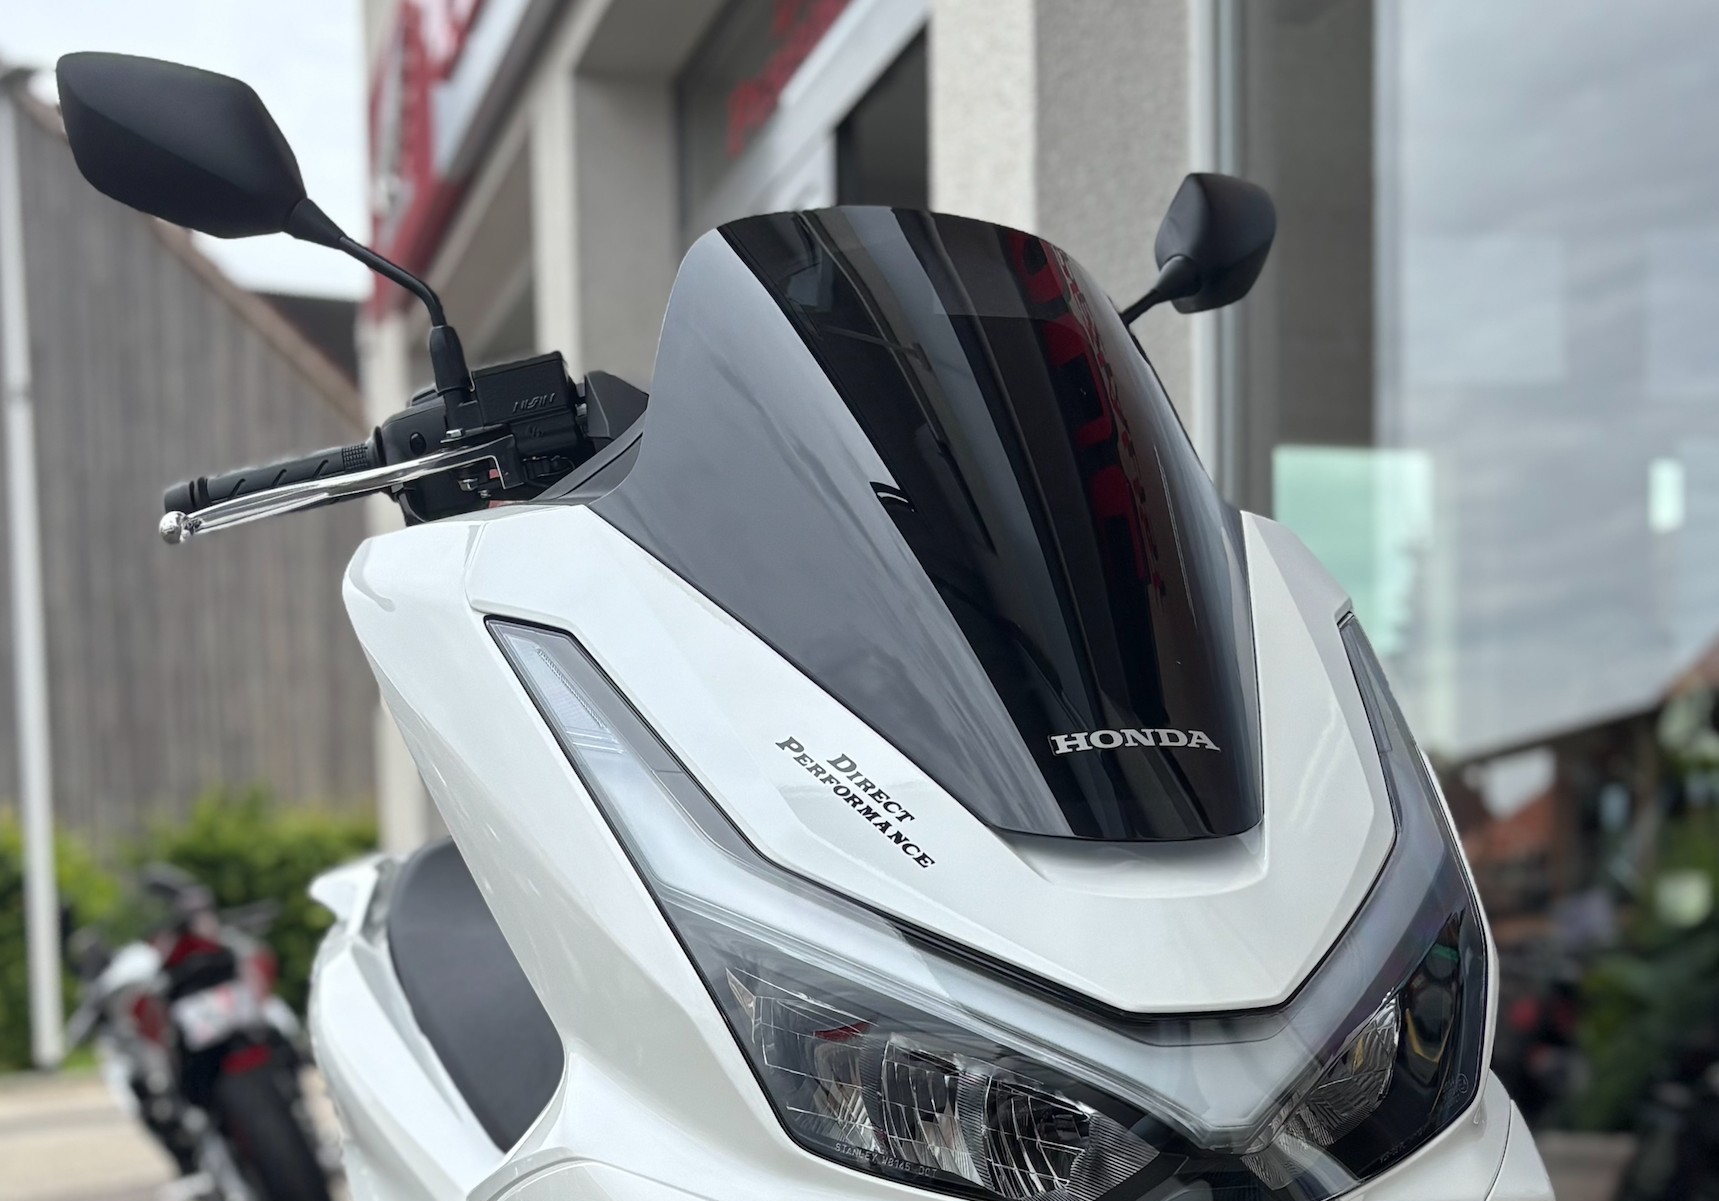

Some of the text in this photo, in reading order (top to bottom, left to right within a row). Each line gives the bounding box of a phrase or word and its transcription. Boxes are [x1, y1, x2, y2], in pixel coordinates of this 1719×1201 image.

[1050, 728, 1221, 755] HONDA
[775, 736, 936, 869] PERFORMANCE
[826, 753, 915, 823] DIRECT
[835, 1142, 878, 1162] STANLEY
